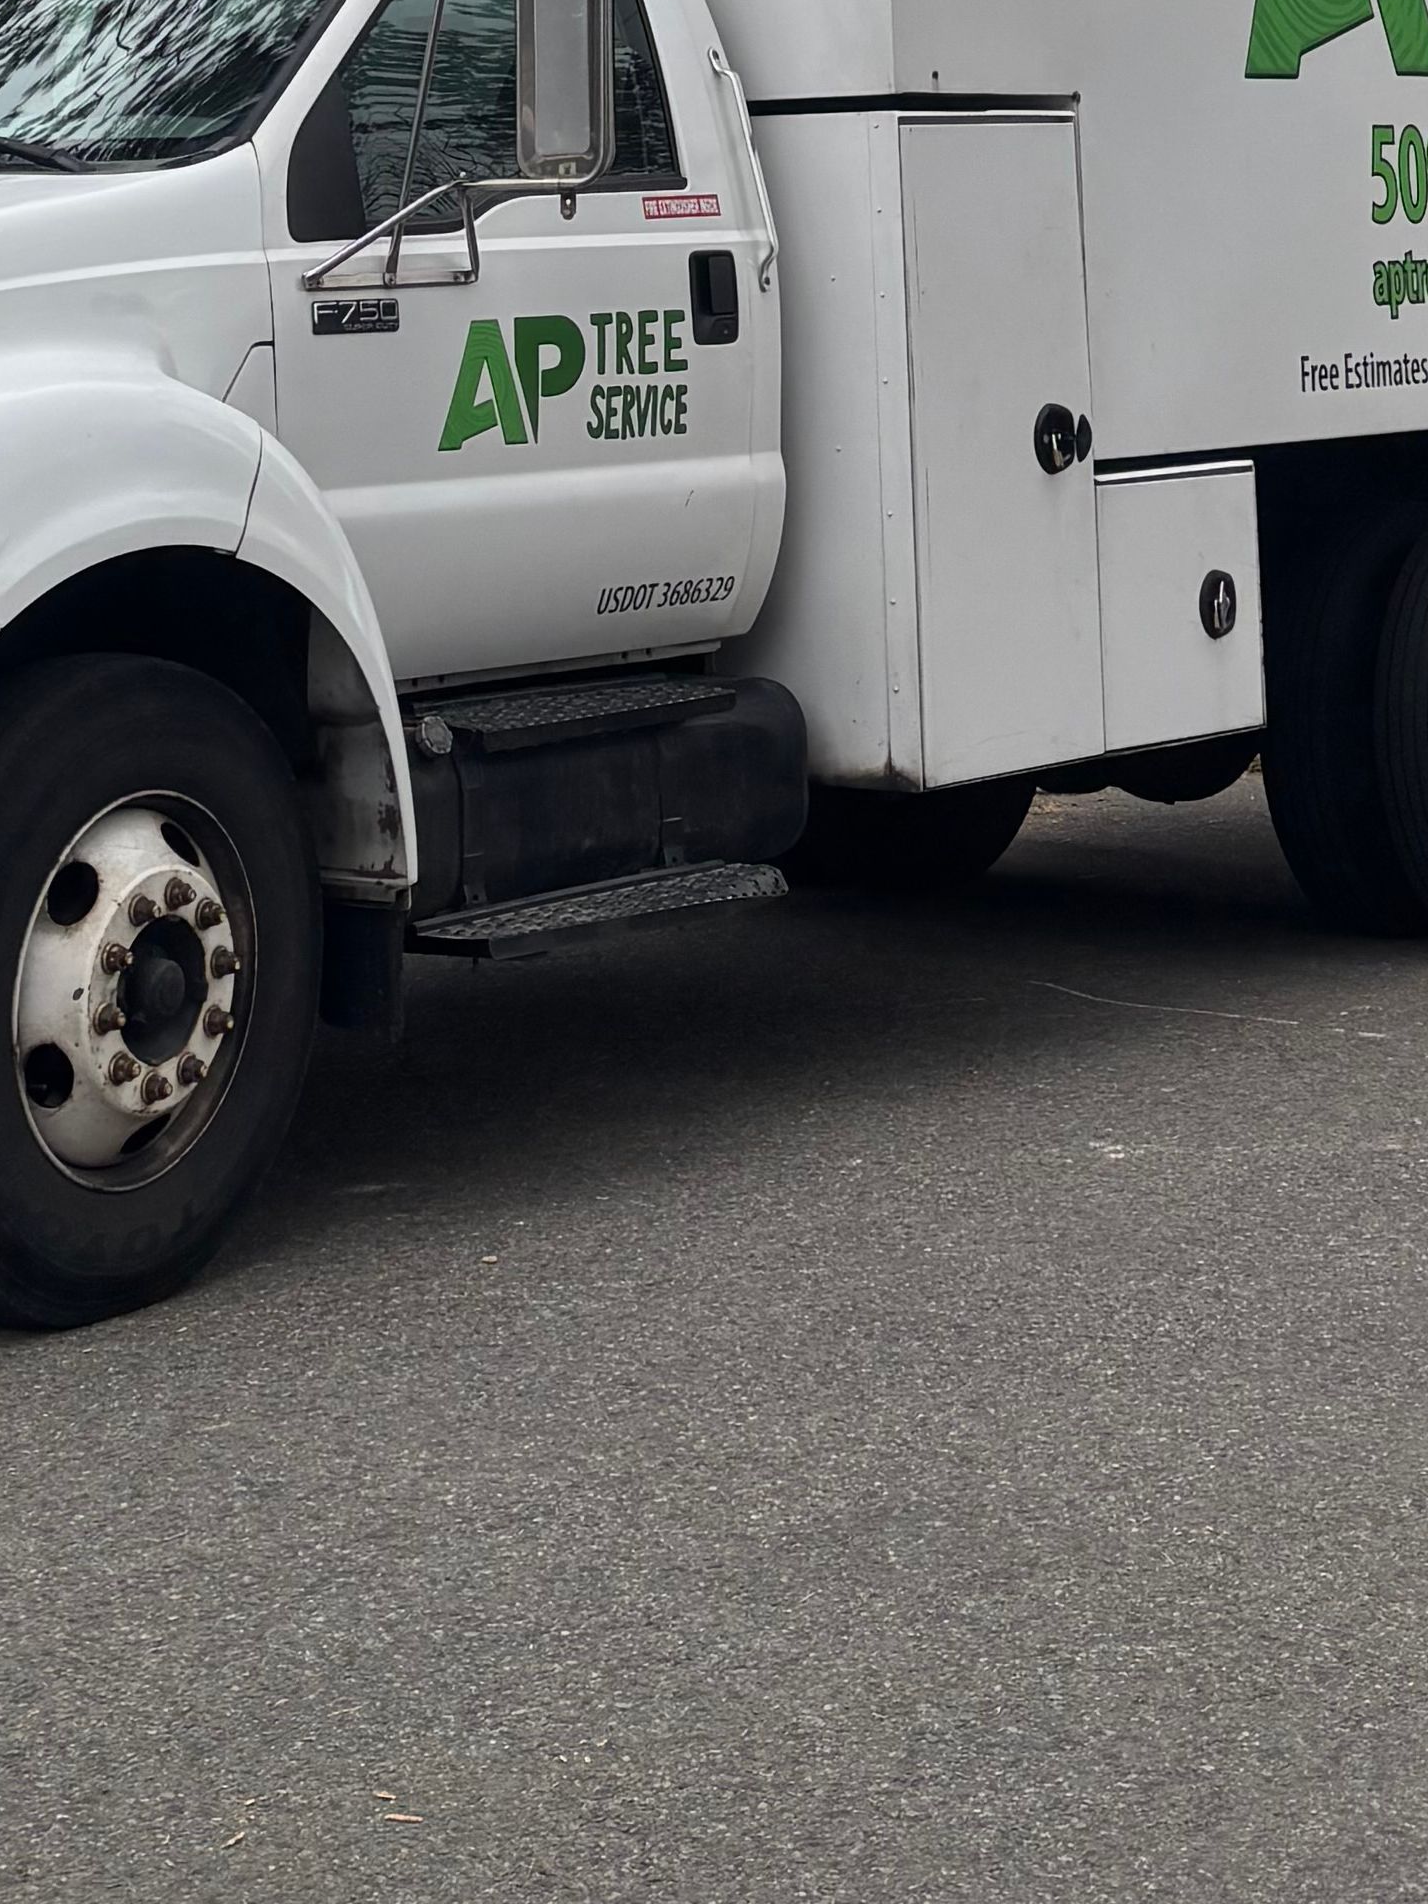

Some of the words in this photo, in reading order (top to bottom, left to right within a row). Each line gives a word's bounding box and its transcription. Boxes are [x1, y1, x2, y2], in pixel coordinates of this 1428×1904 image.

[438, 315, 586, 452] AP
[590, 309, 689, 375] TREE
[1300, 354, 1340, 392] Free
[1344, 351, 1428, 389] Estimates
[586, 384, 688, 440] SERVICE
[597, 583, 658, 615] USDOT
[656, 575, 735, 609] 3686329
